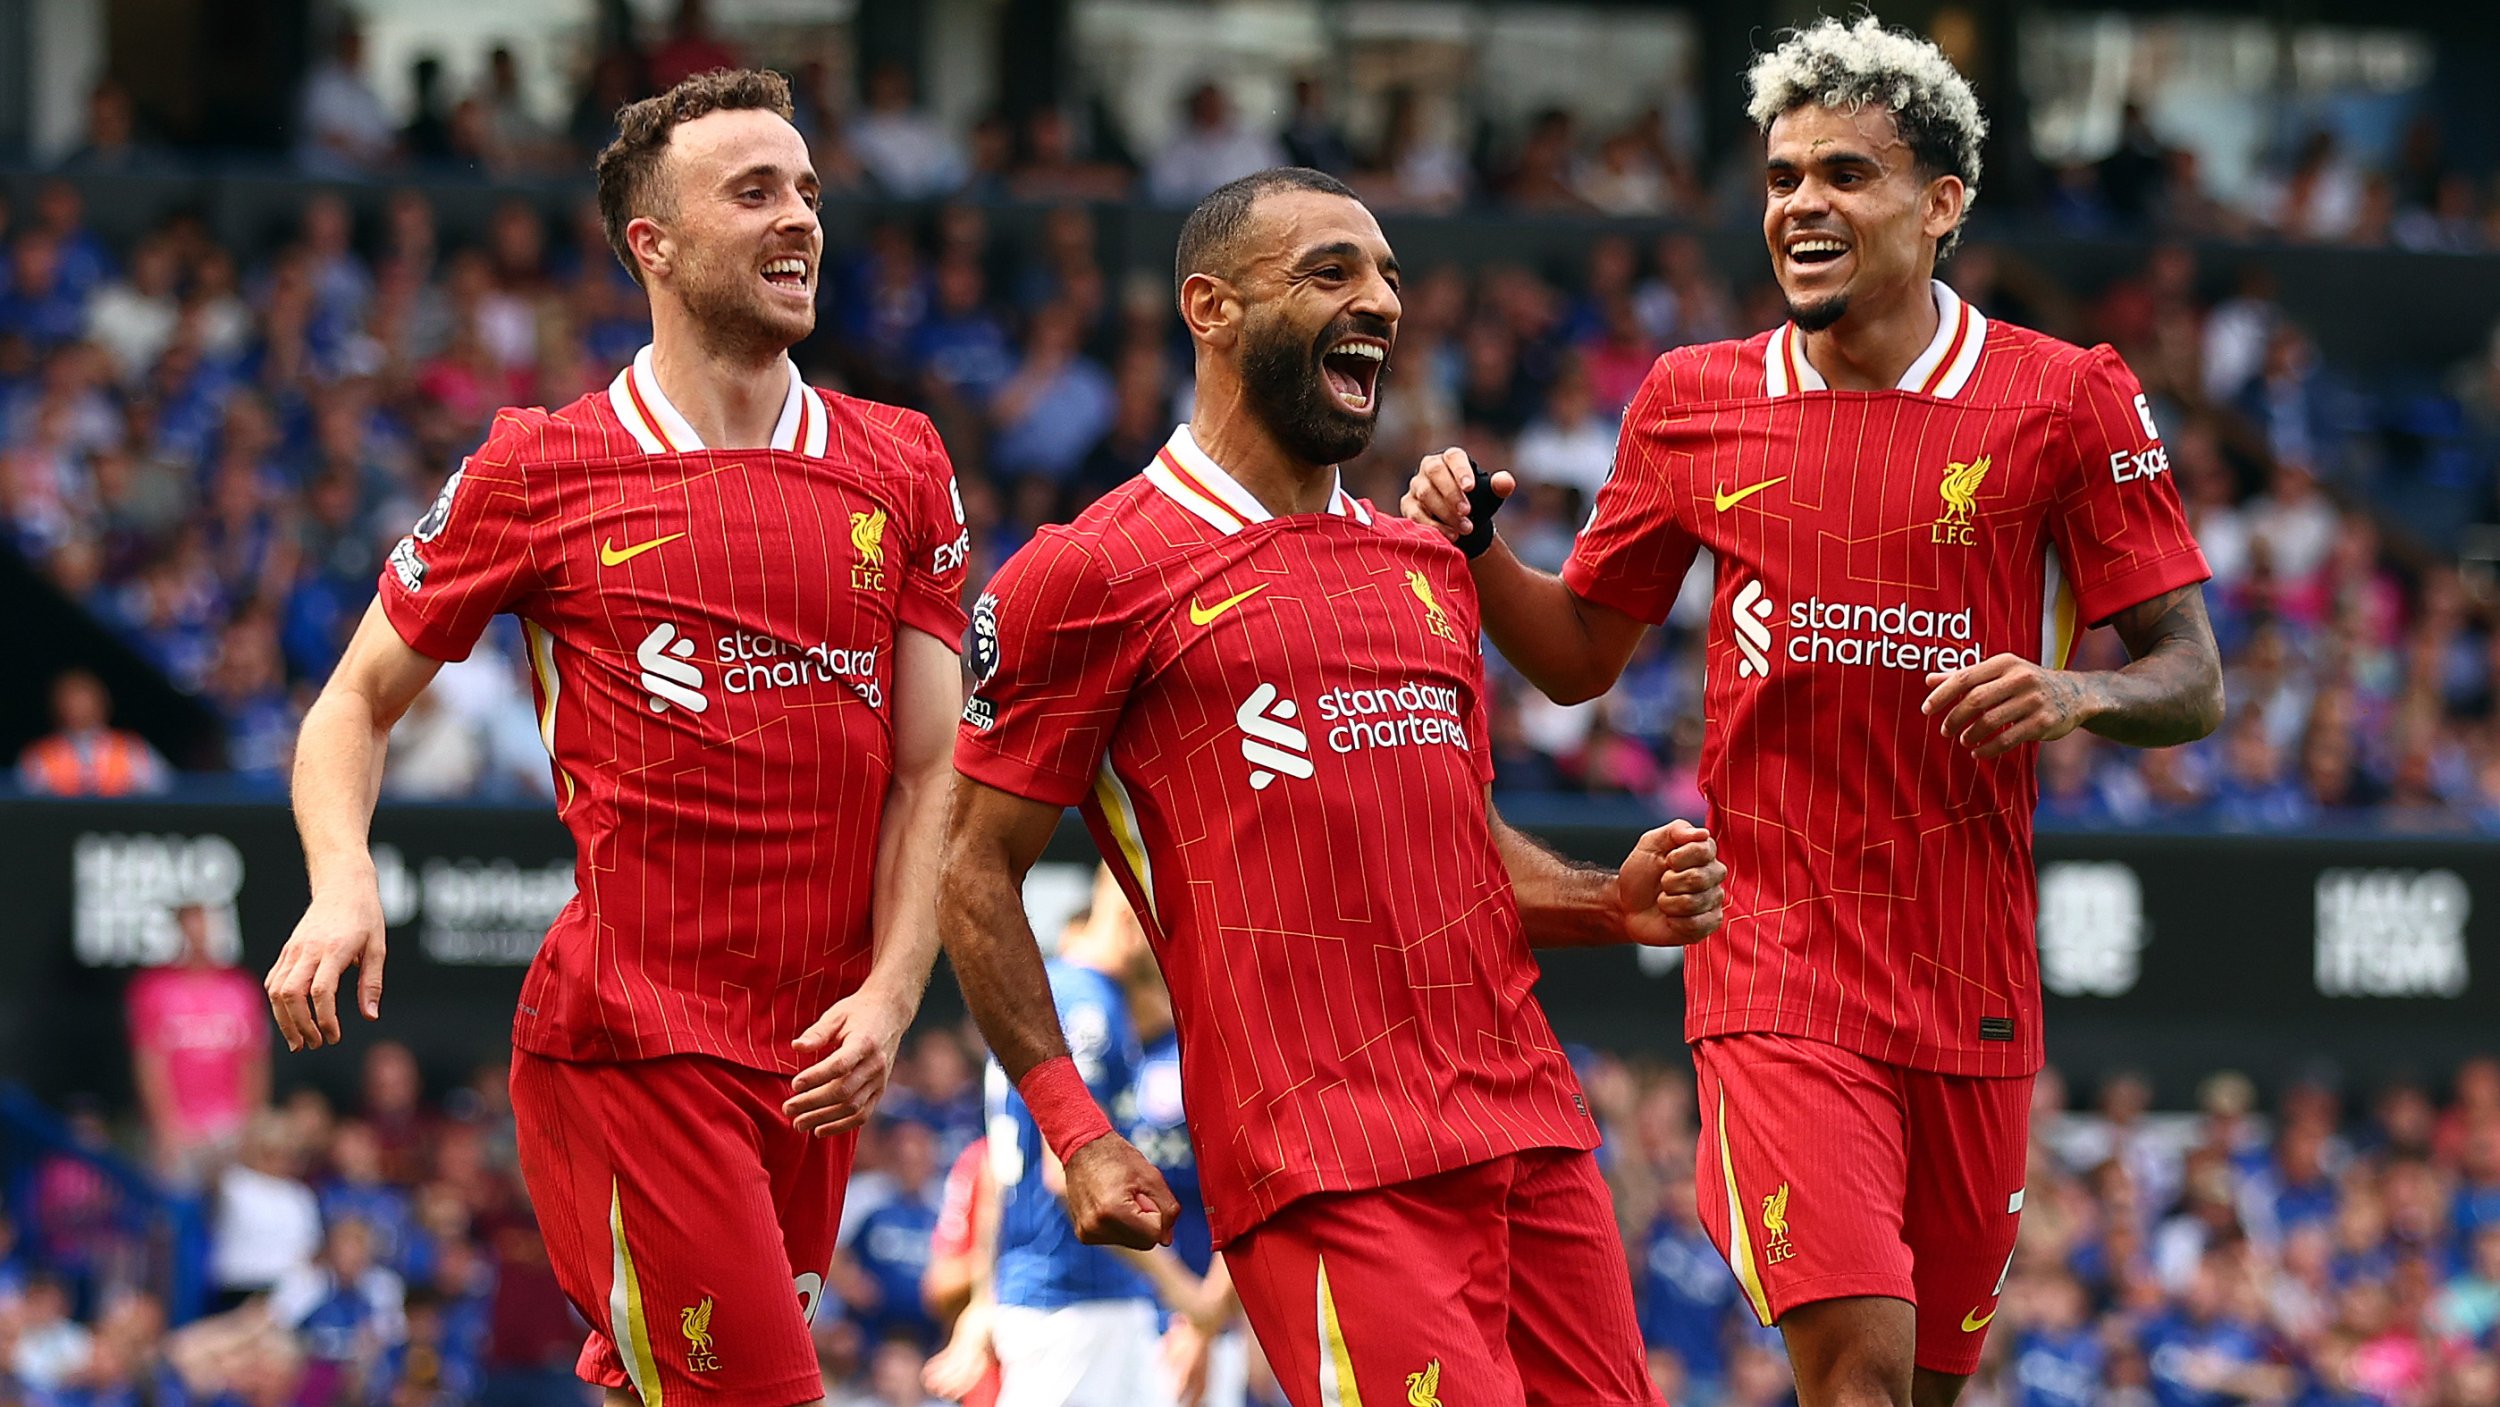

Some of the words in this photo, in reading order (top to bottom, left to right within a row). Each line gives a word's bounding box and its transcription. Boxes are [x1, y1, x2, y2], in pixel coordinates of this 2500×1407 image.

[1931, 525, 1977, 546] L.F.C.
[851, 570, 886, 591] L.F.C.
[1790, 596, 1971, 640] standard
[1788, 630, 1980, 673] chartered
[1318, 681, 1458, 720] standard
[1329, 713, 1469, 753] chartered
[1766, 1243, 1797, 1265] L.F.C.
[687, 1356, 722, 1372] L.F.C.
